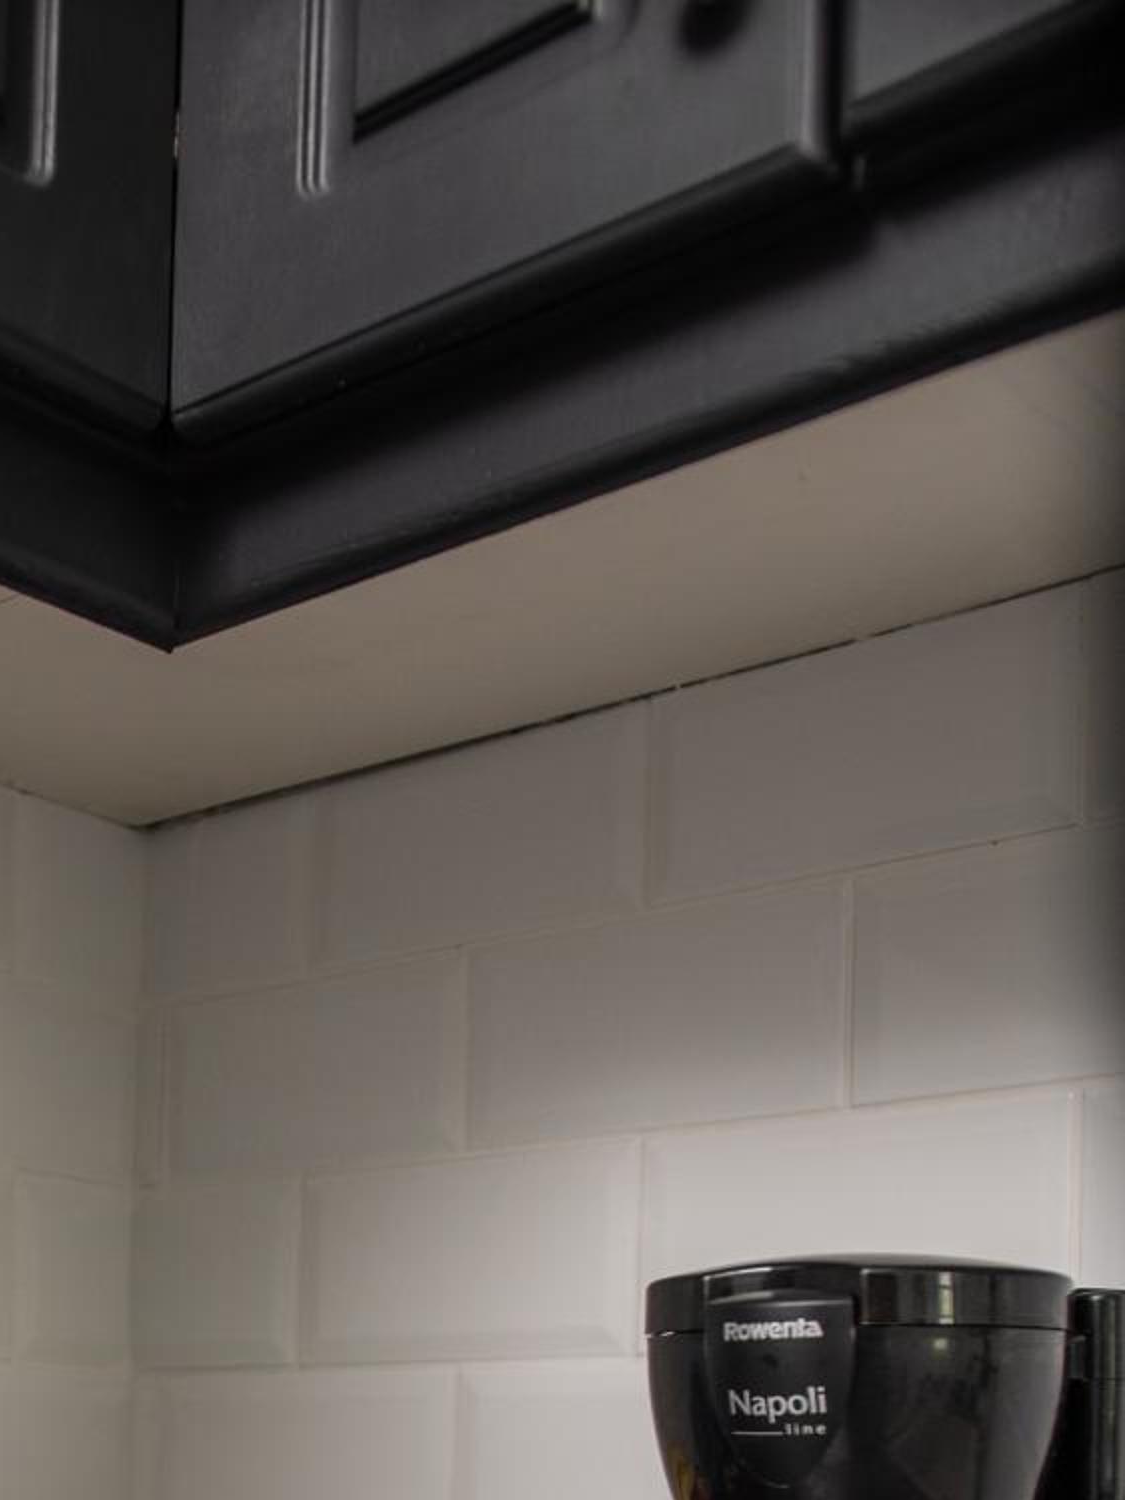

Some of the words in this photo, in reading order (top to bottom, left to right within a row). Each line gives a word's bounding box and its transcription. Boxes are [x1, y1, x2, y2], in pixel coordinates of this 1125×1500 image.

[724, 1318, 824, 1341] Rowenta
[728, 1386, 827, 1424] Napoli
[784, 1423, 827, 1436] line
